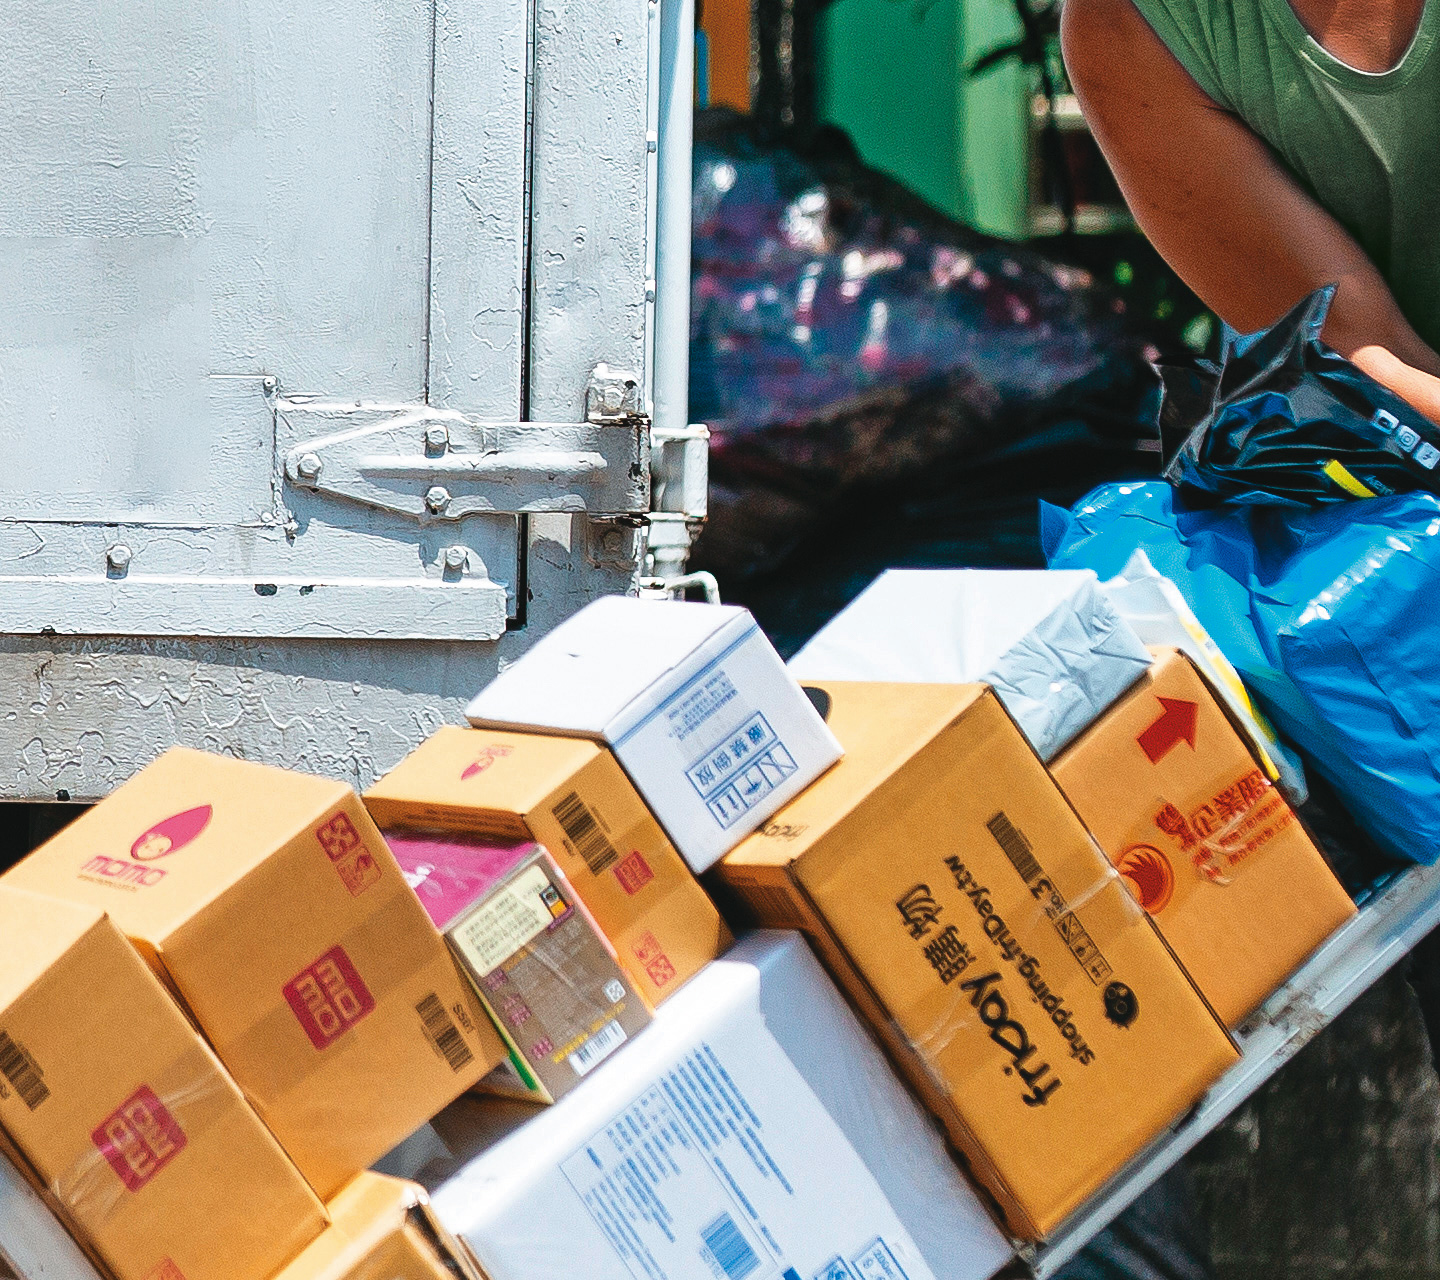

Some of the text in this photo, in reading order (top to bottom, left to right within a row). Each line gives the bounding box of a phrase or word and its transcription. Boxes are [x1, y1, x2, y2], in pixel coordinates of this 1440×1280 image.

[694, 723, 766, 786] 嚴禁倒放
[80, 854, 168, 888] momo
[1030, 878, 1053, 900] 3
[943, 854, 1096, 1066] shopping.friDay.tw
